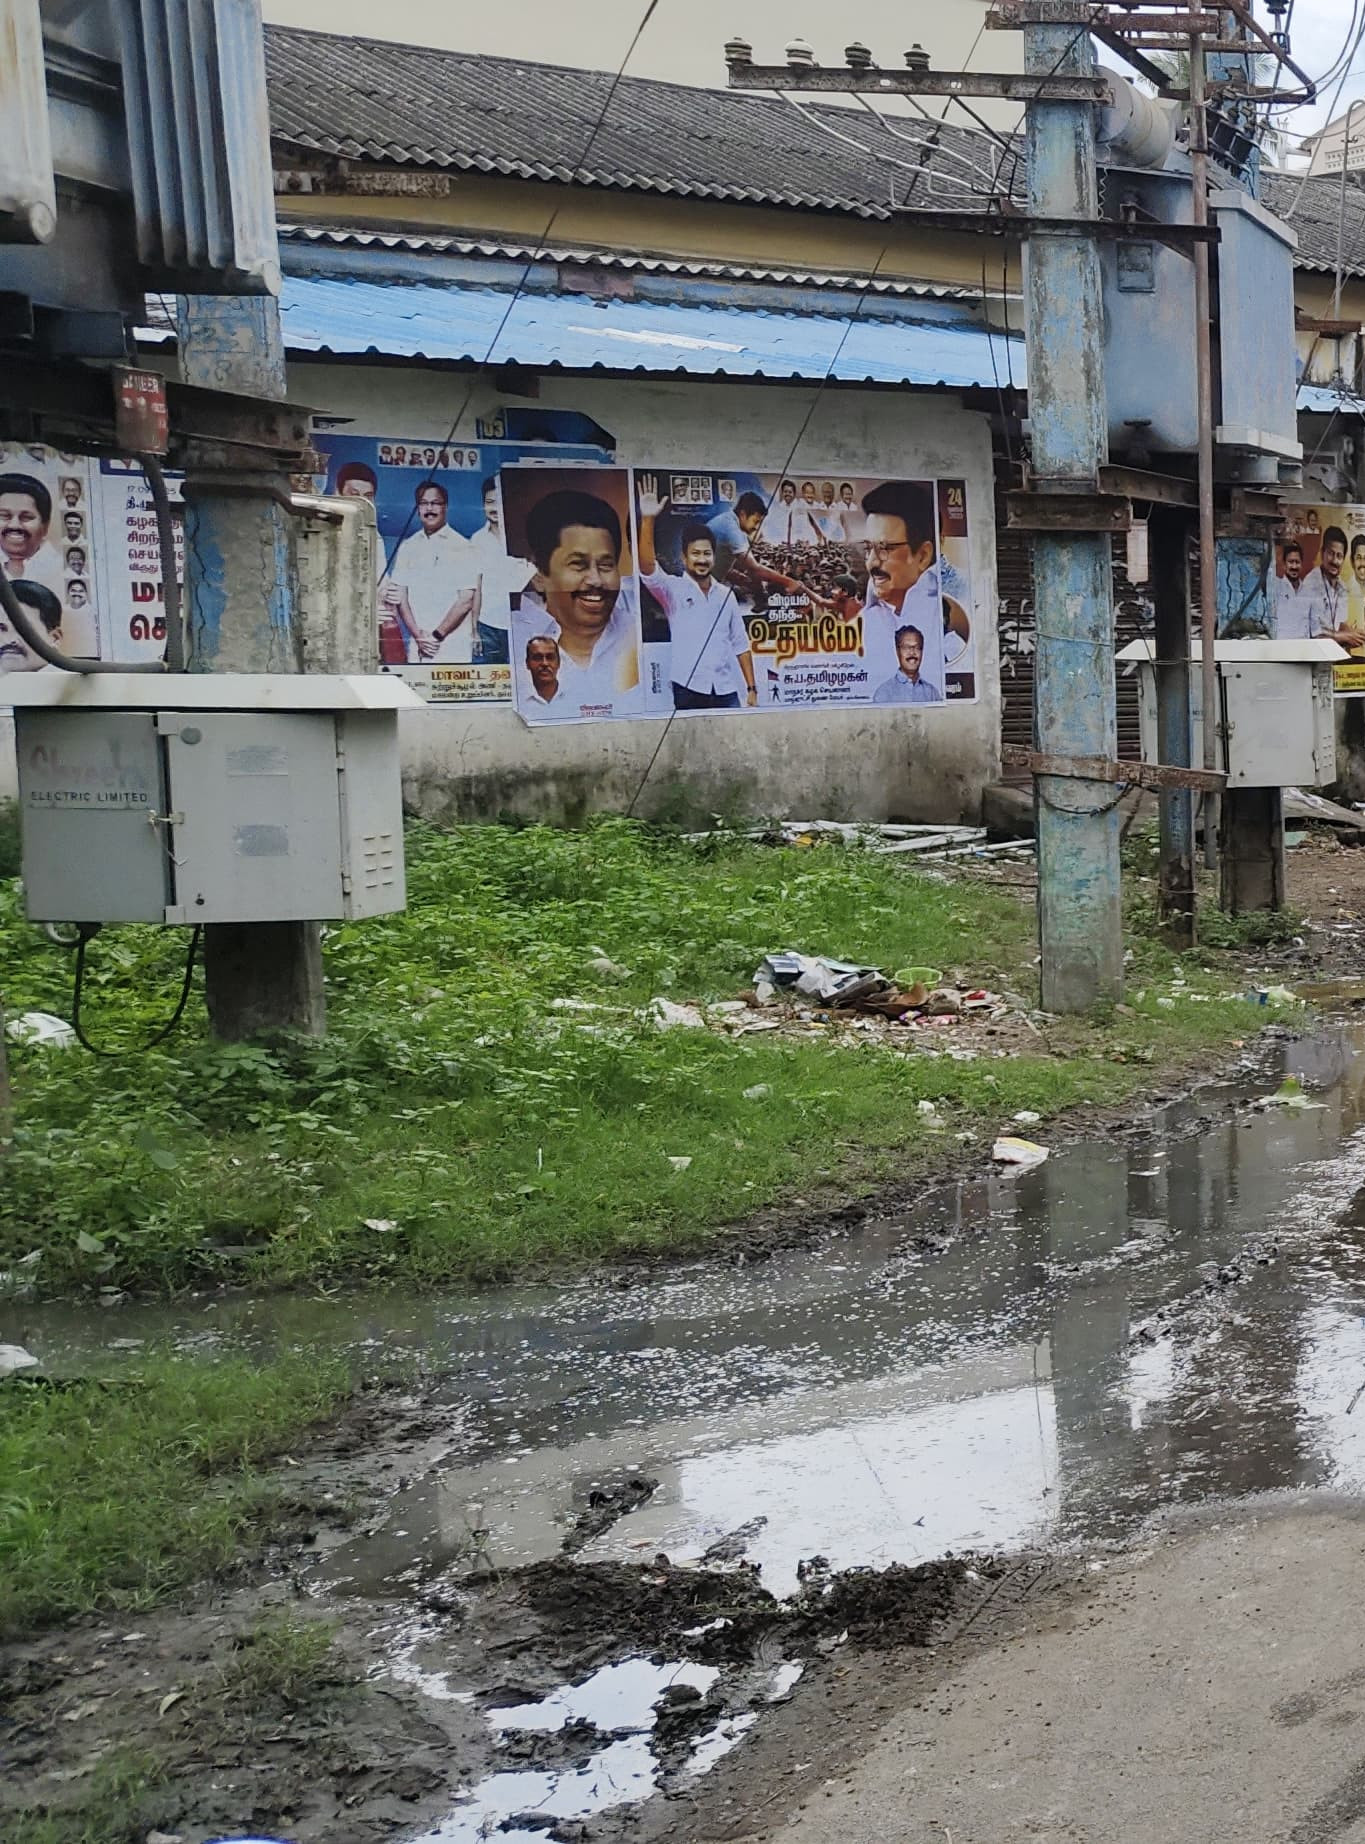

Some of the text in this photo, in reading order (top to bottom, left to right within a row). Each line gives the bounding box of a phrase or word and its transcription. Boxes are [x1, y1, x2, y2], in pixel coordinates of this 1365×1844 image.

[768, 593, 810, 609] விடியல்
[749, 613, 865, 668] உதயமே!
[431, 669, 487, 681] மாவட்ட
[31, 791, 148, 803] ELECTRIC LIMITED
